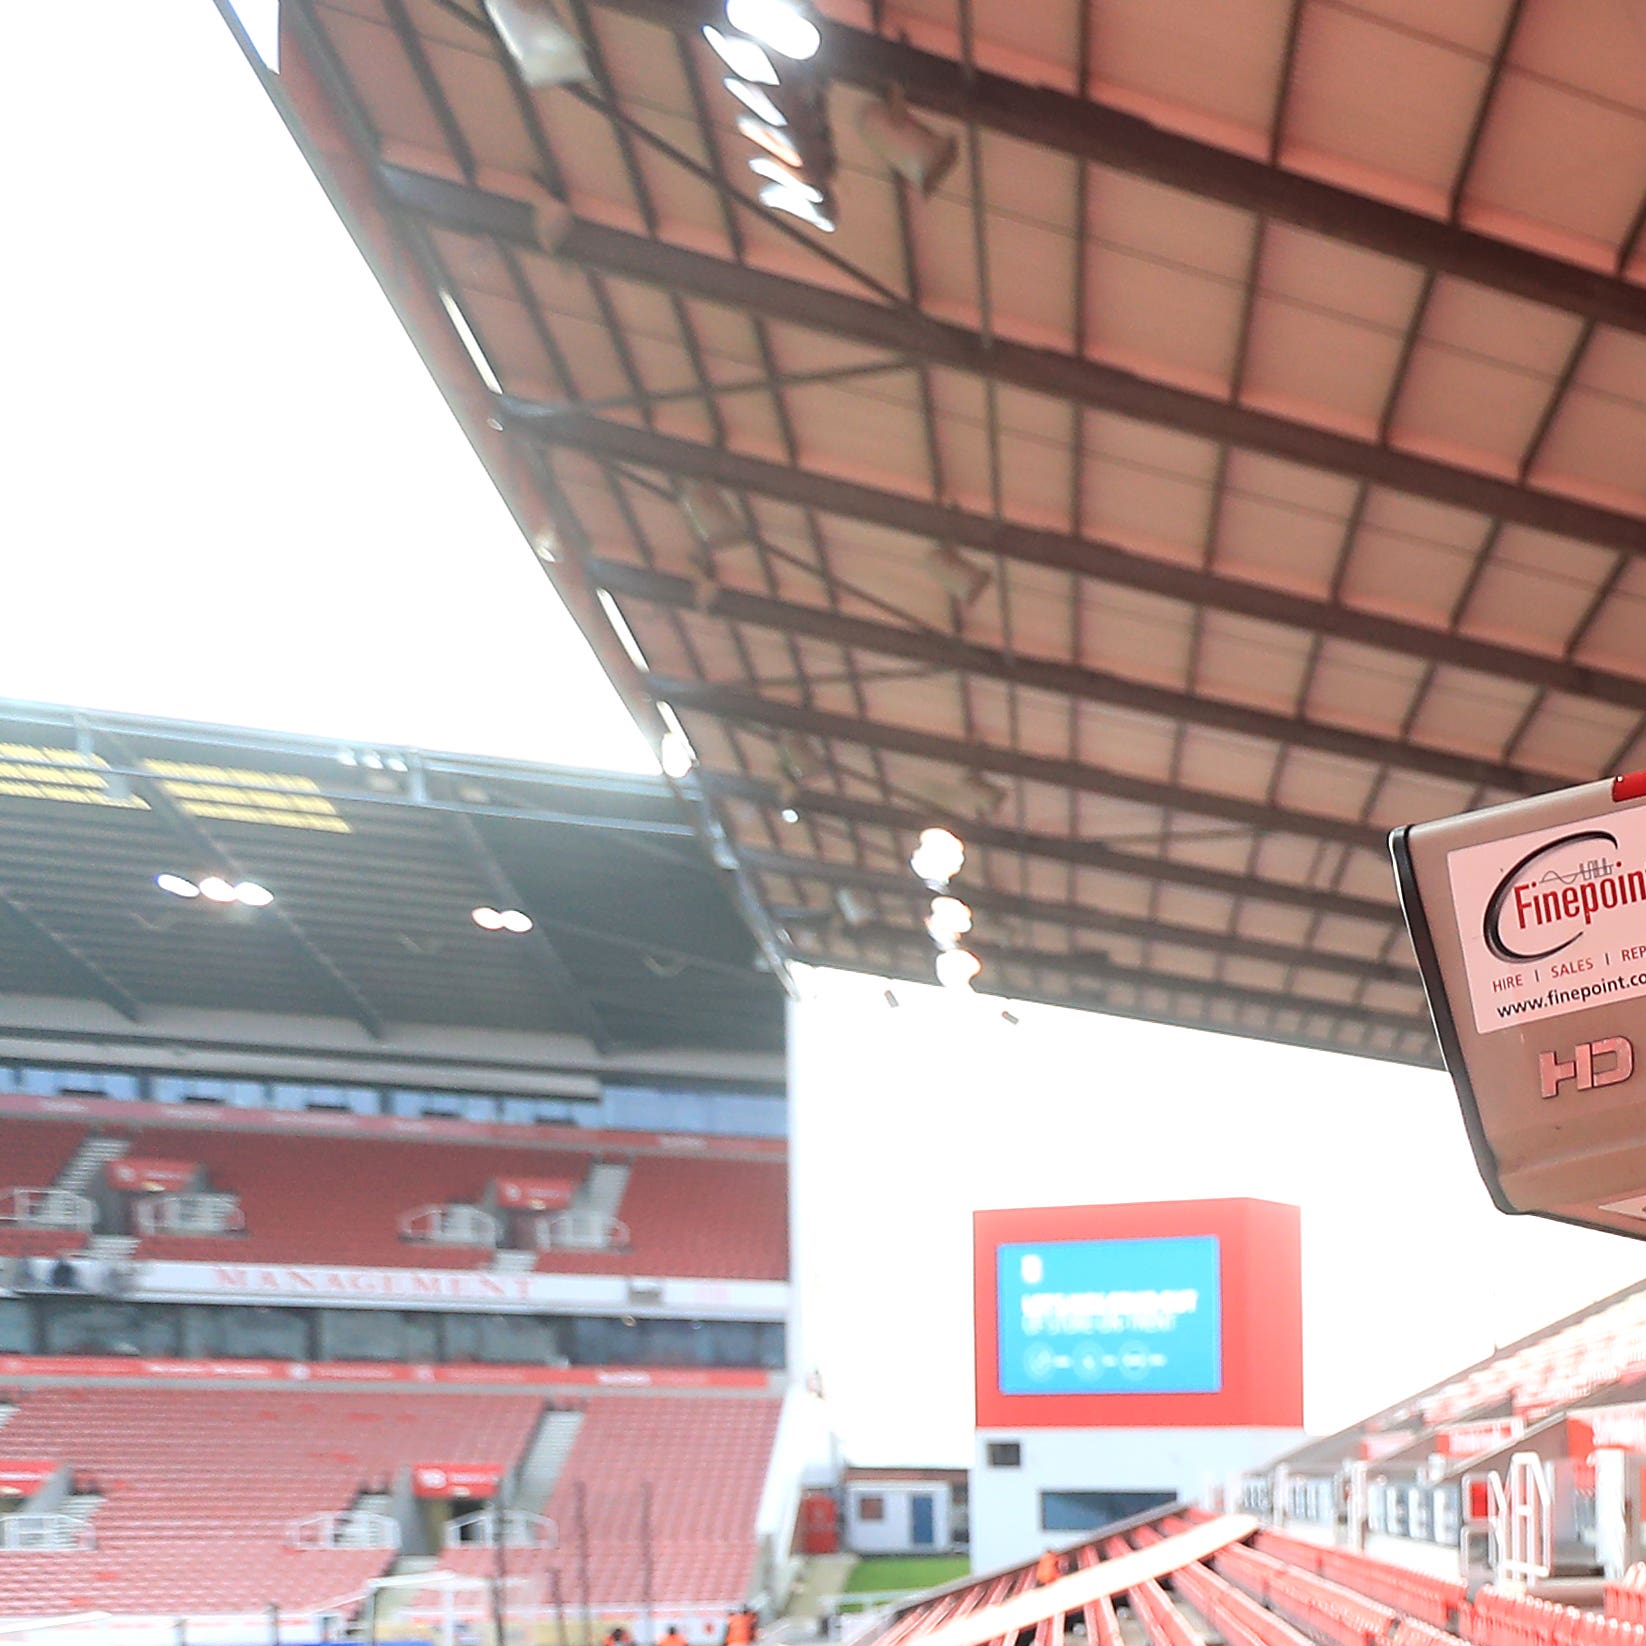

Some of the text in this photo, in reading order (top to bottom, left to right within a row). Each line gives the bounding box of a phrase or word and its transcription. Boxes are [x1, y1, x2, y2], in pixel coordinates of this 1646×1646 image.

[1492, 974, 1524, 994] HIRE
[1550, 958, 1595, 979] SALES
[1537, 1035, 1635, 1100] HD
[216, 1268, 536, 1299] MANAGEMENT
